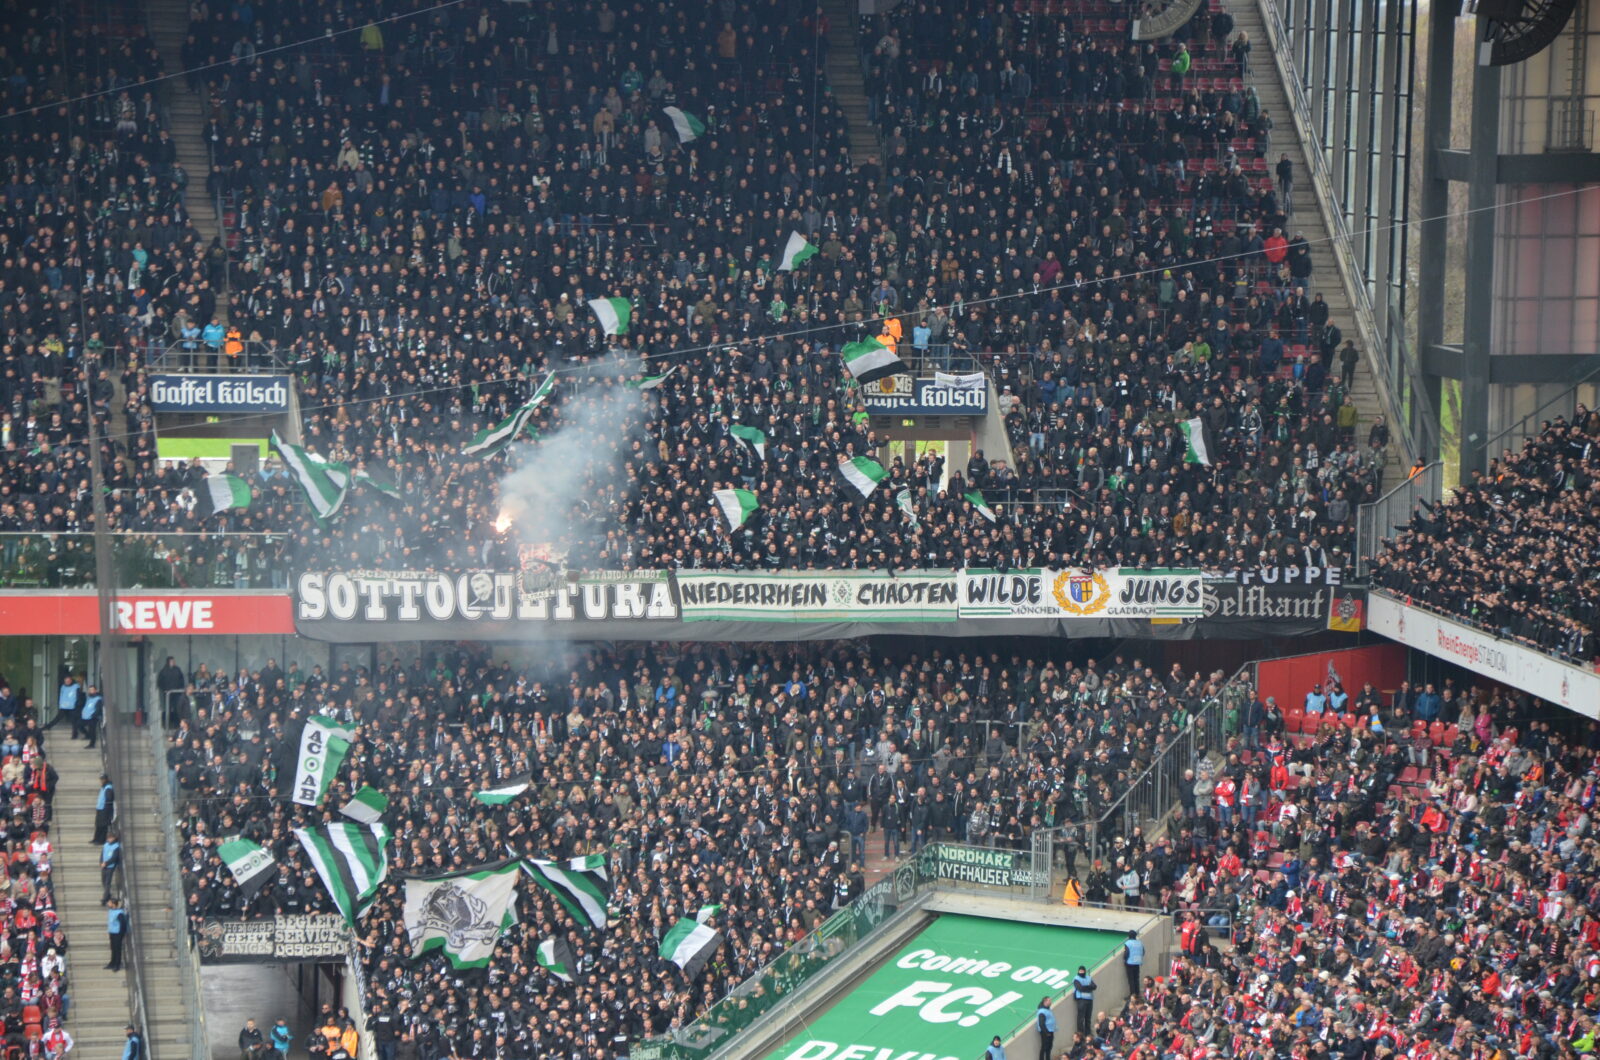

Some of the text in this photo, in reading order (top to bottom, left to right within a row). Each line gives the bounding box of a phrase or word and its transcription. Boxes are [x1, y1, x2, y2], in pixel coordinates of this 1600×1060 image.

[152, 380, 287, 408] Gaffel Kölsch
[681, 581, 958, 607] NIEDERRHEIN CHAOTEN
[967, 576, 1201, 605] WILDE JUNGS
[109, 600, 214, 630] REWE
[1011, 605, 1060, 615] MÖNCHEN
[938, 846, 1013, 868] NORDHARZ
[938, 861, 1010, 886] KYFFHÄUSER
[274, 929, 341, 943] SERVICE
[896, 948, 1071, 989] Come on,
[869, 980, 1024, 1027] FC!
